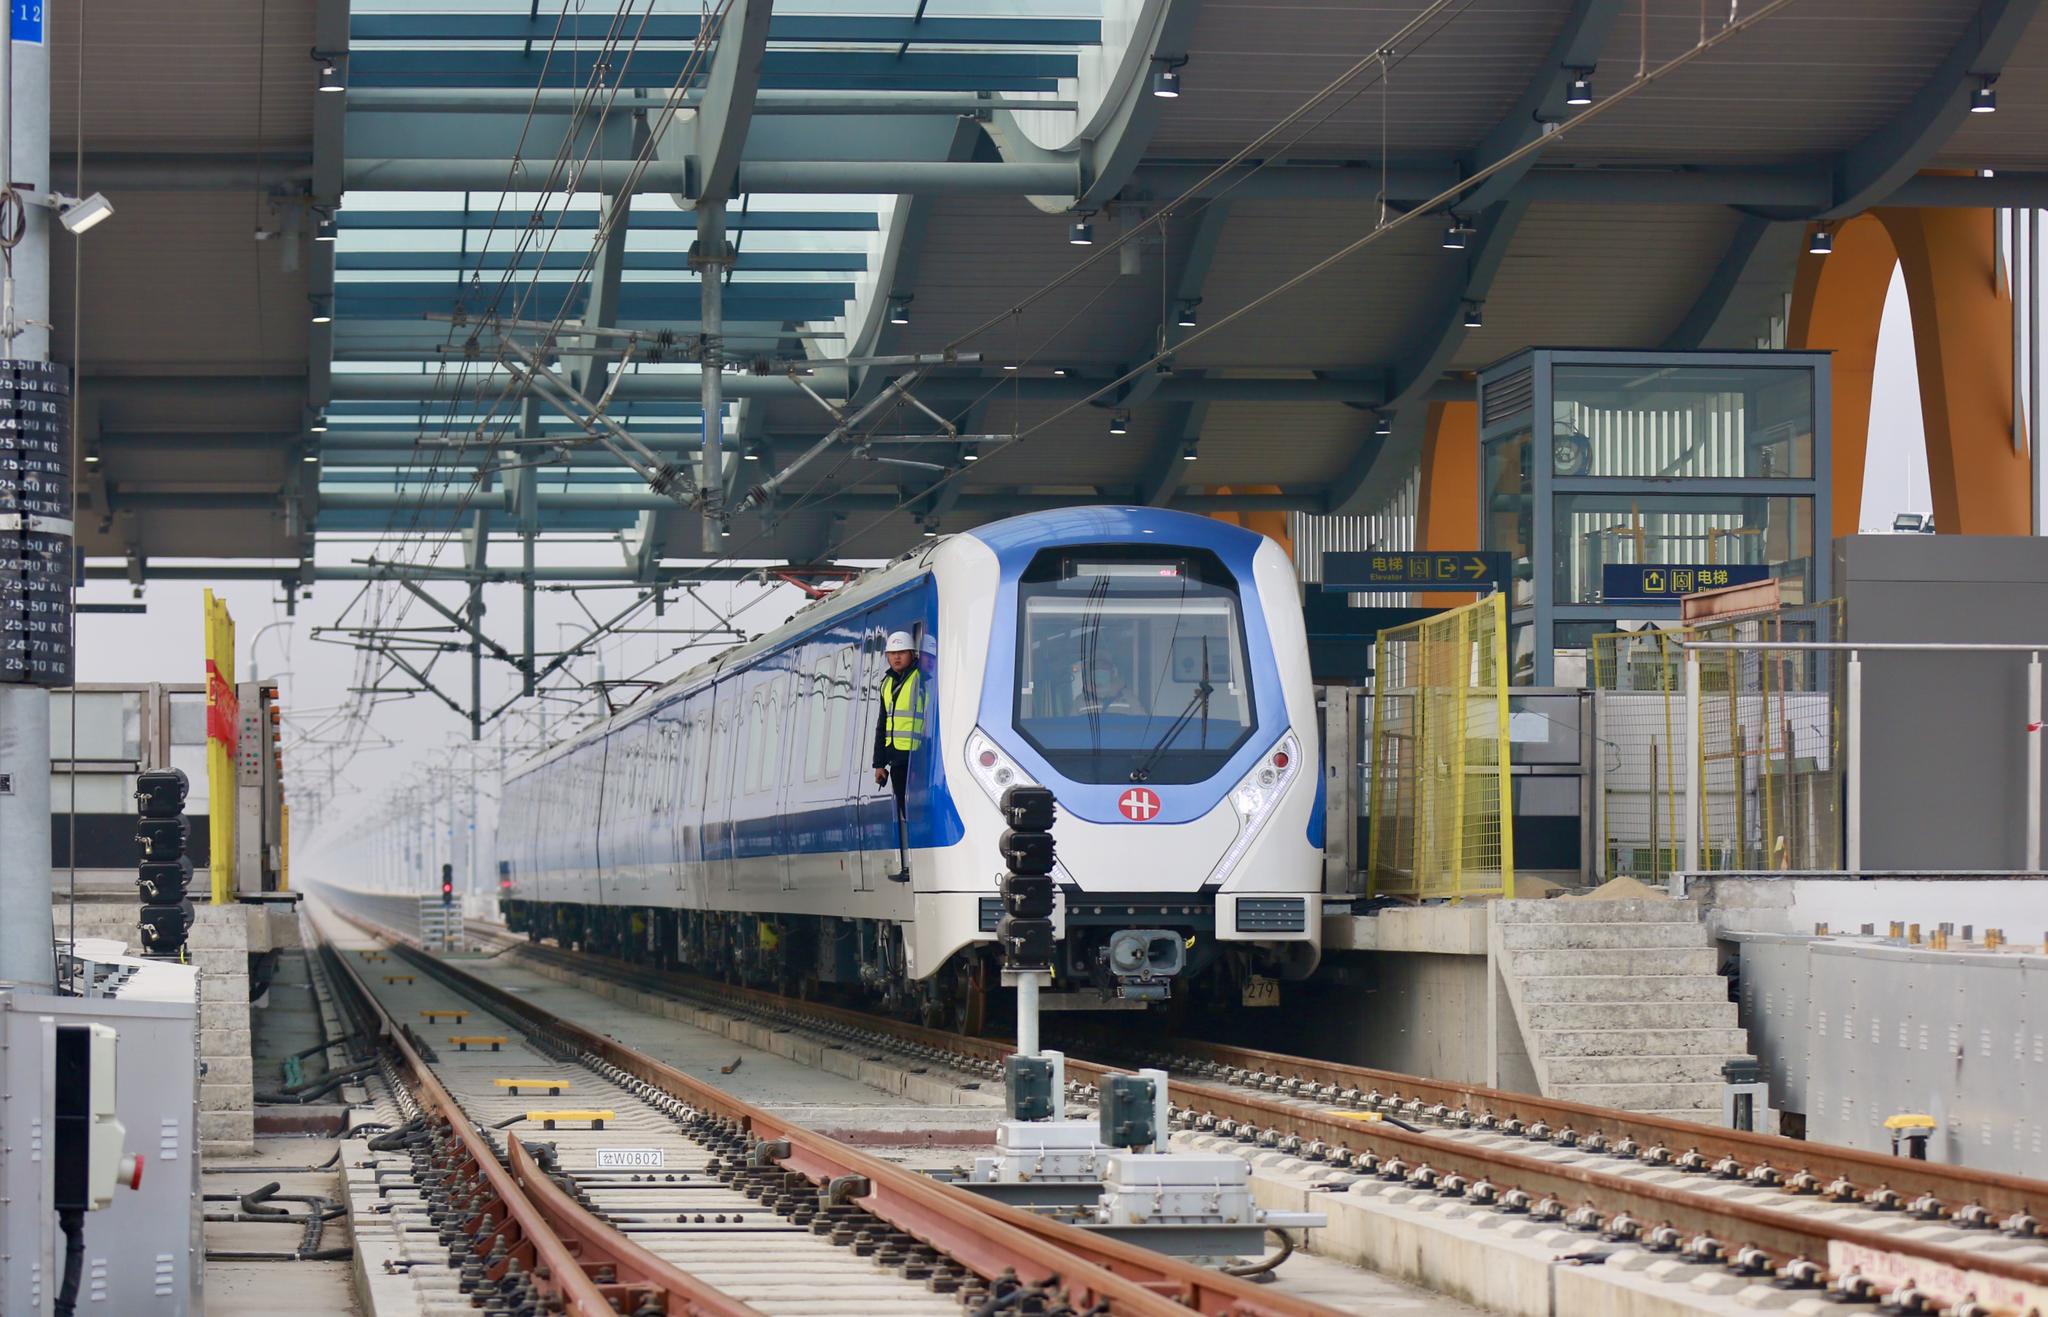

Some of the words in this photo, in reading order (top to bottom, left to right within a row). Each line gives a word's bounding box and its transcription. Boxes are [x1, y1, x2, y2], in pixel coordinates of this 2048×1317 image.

[0, 360, 34, 370] 5.50
[42, 401, 57, 414] KG
[44, 440, 58, 453] KG
[46, 482, 60, 494] KG
[1, 538, 43, 551] 25.50
[48, 541, 63, 553] KG
[1372, 557, 1403, 572] 电梯
[1370, 573, 1402, 581] Elevator
[1698, 569, 1728, 584] 电梯
[5, 619, 46, 632] 25.50
[5, 658, 47, 671] 25.10
[52, 661, 65, 674] KG
[1248, 983, 1274, 998] 279
